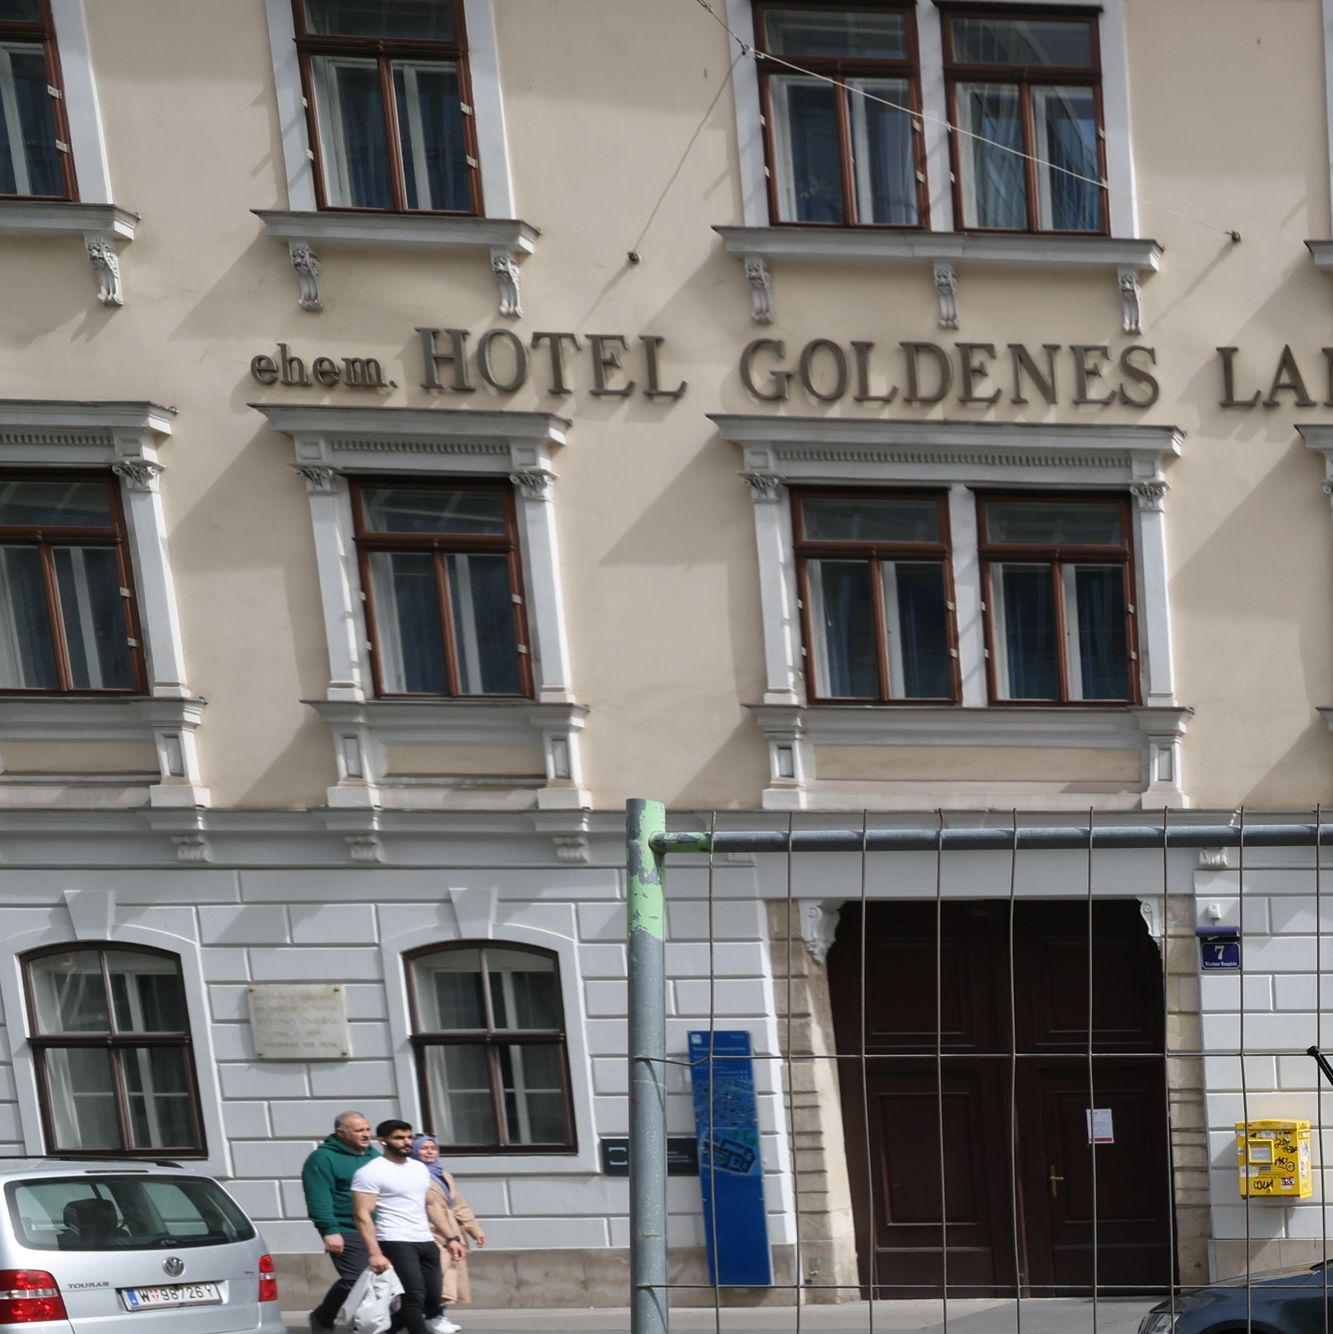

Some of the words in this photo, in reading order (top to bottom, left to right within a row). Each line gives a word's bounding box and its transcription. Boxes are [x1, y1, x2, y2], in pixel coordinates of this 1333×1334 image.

[250, 343, 398, 389] ehem.
[413, 327, 687, 398] HOTEL
[739, 338, 1160, 402] GOLDENES
[1214, 944, 1225, 960] 7
[138, 1288, 150, 1303] W
